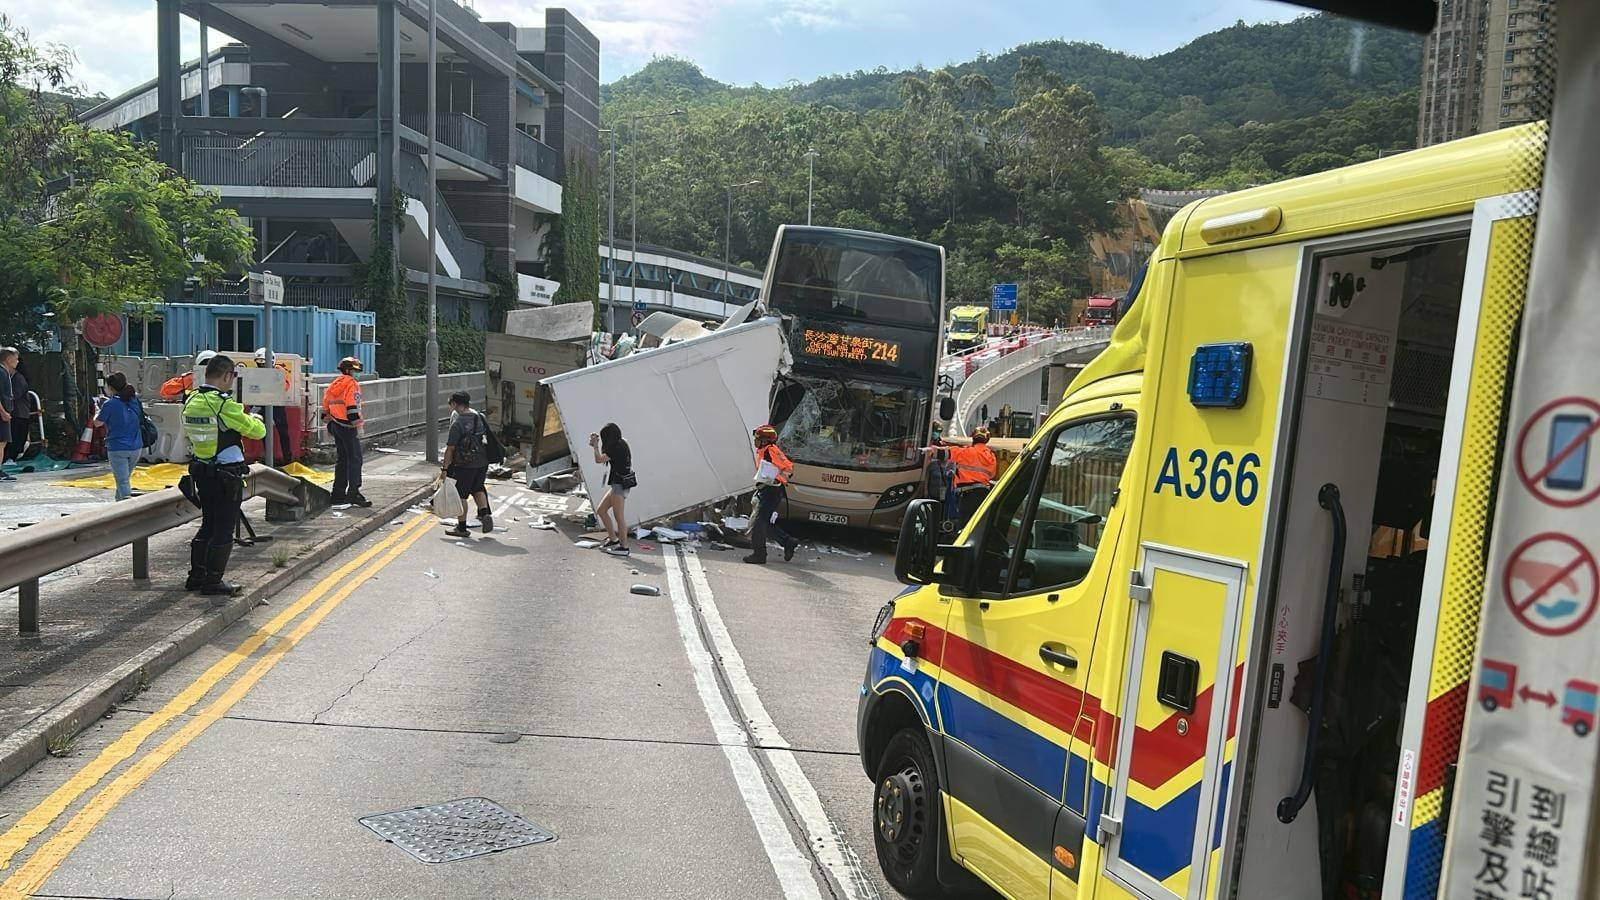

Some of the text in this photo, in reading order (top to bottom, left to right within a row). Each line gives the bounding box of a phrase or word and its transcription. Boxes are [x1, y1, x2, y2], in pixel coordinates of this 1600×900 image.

[871, 342, 898, 362] 214
[829, 473, 850, 485] KMB
[1153, 447, 1261, 506] A366
[811, 512, 846, 523] TK 2540
